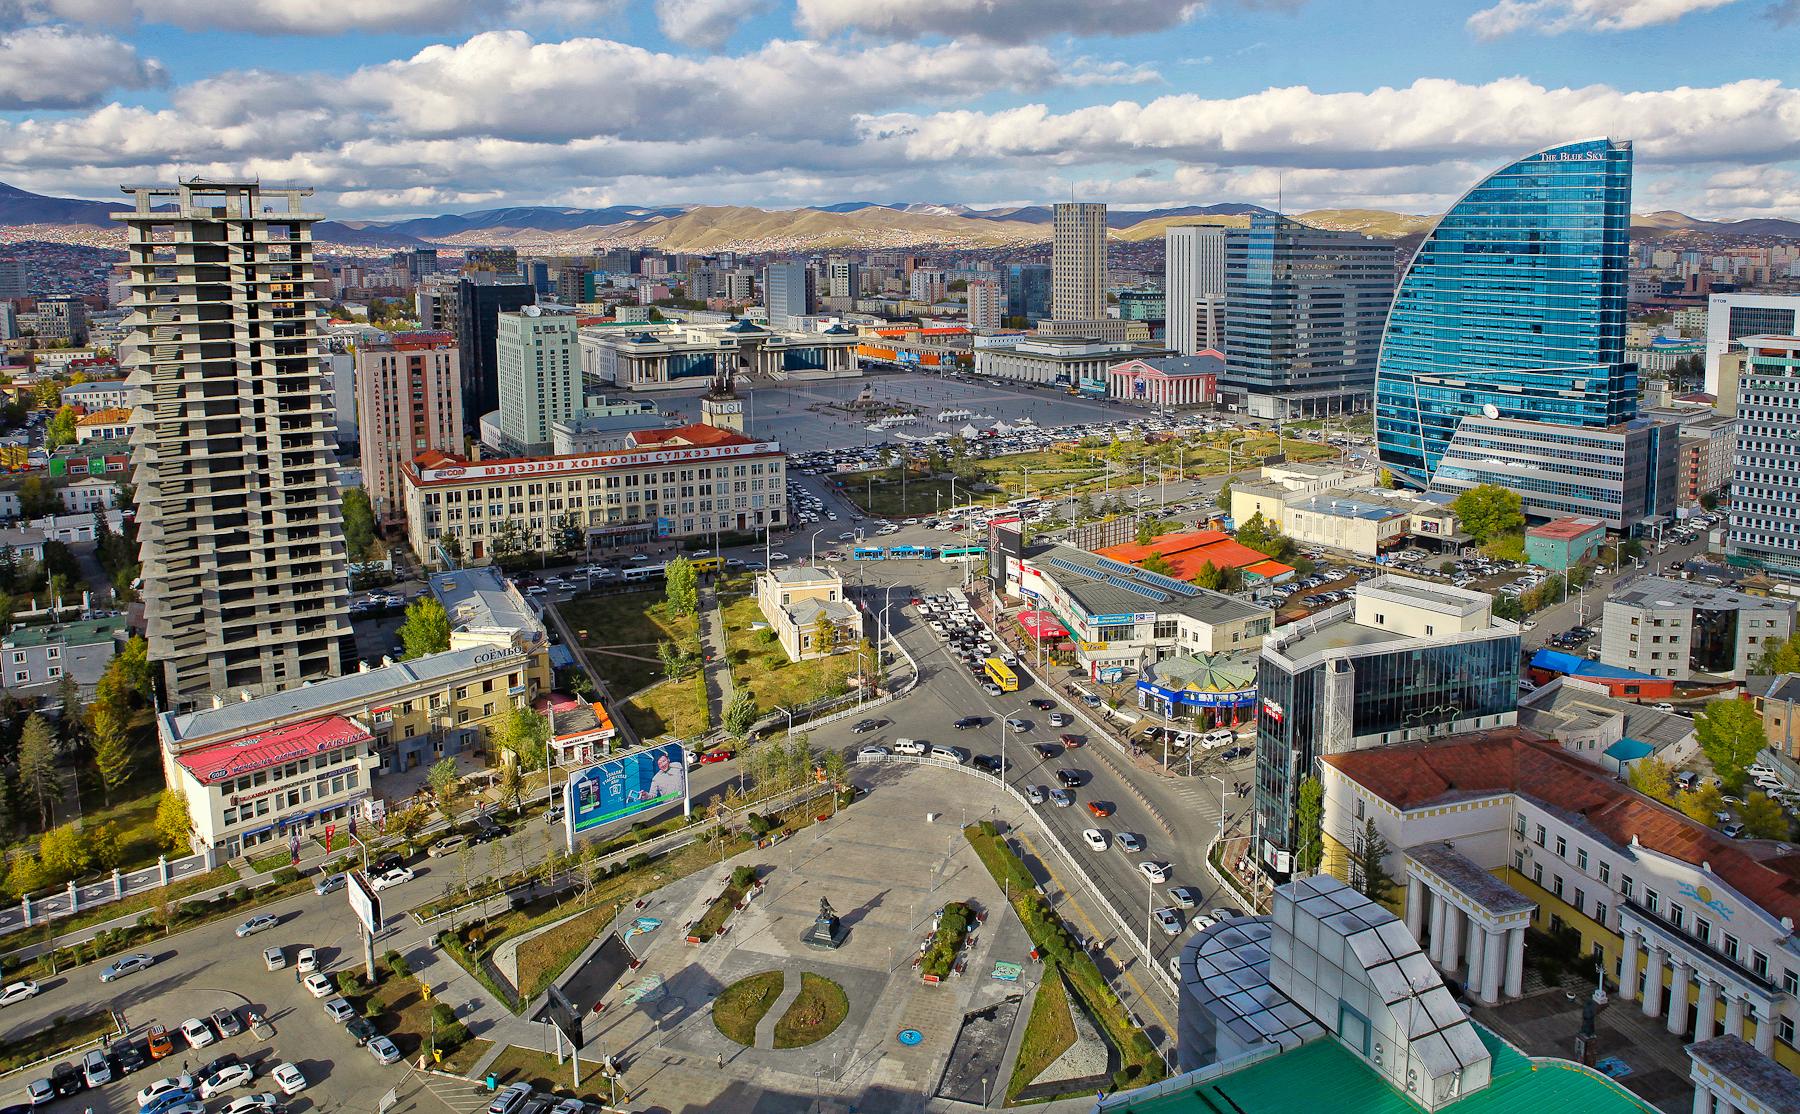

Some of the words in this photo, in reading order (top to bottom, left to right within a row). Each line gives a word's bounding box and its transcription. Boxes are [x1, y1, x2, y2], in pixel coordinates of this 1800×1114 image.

[1540, 153, 1556, 161] THE
[1560, 152, 1583, 160] BLUE
[1586, 151, 1604, 160] SKY
[373, 371, 382, 435] ULAANBAATAR
[485, 462, 564, 475] МЭДЭЭЛЭЛ
[571, 453, 649, 469] ХОЛБООНЫ
[656, 449, 710, 461] СҮЛЖЭЭ
[717, 446, 741, 455] ТӨК
[474, 646, 522, 664] СОЁМБО
[326, 732, 368, 750] AIRLINK
